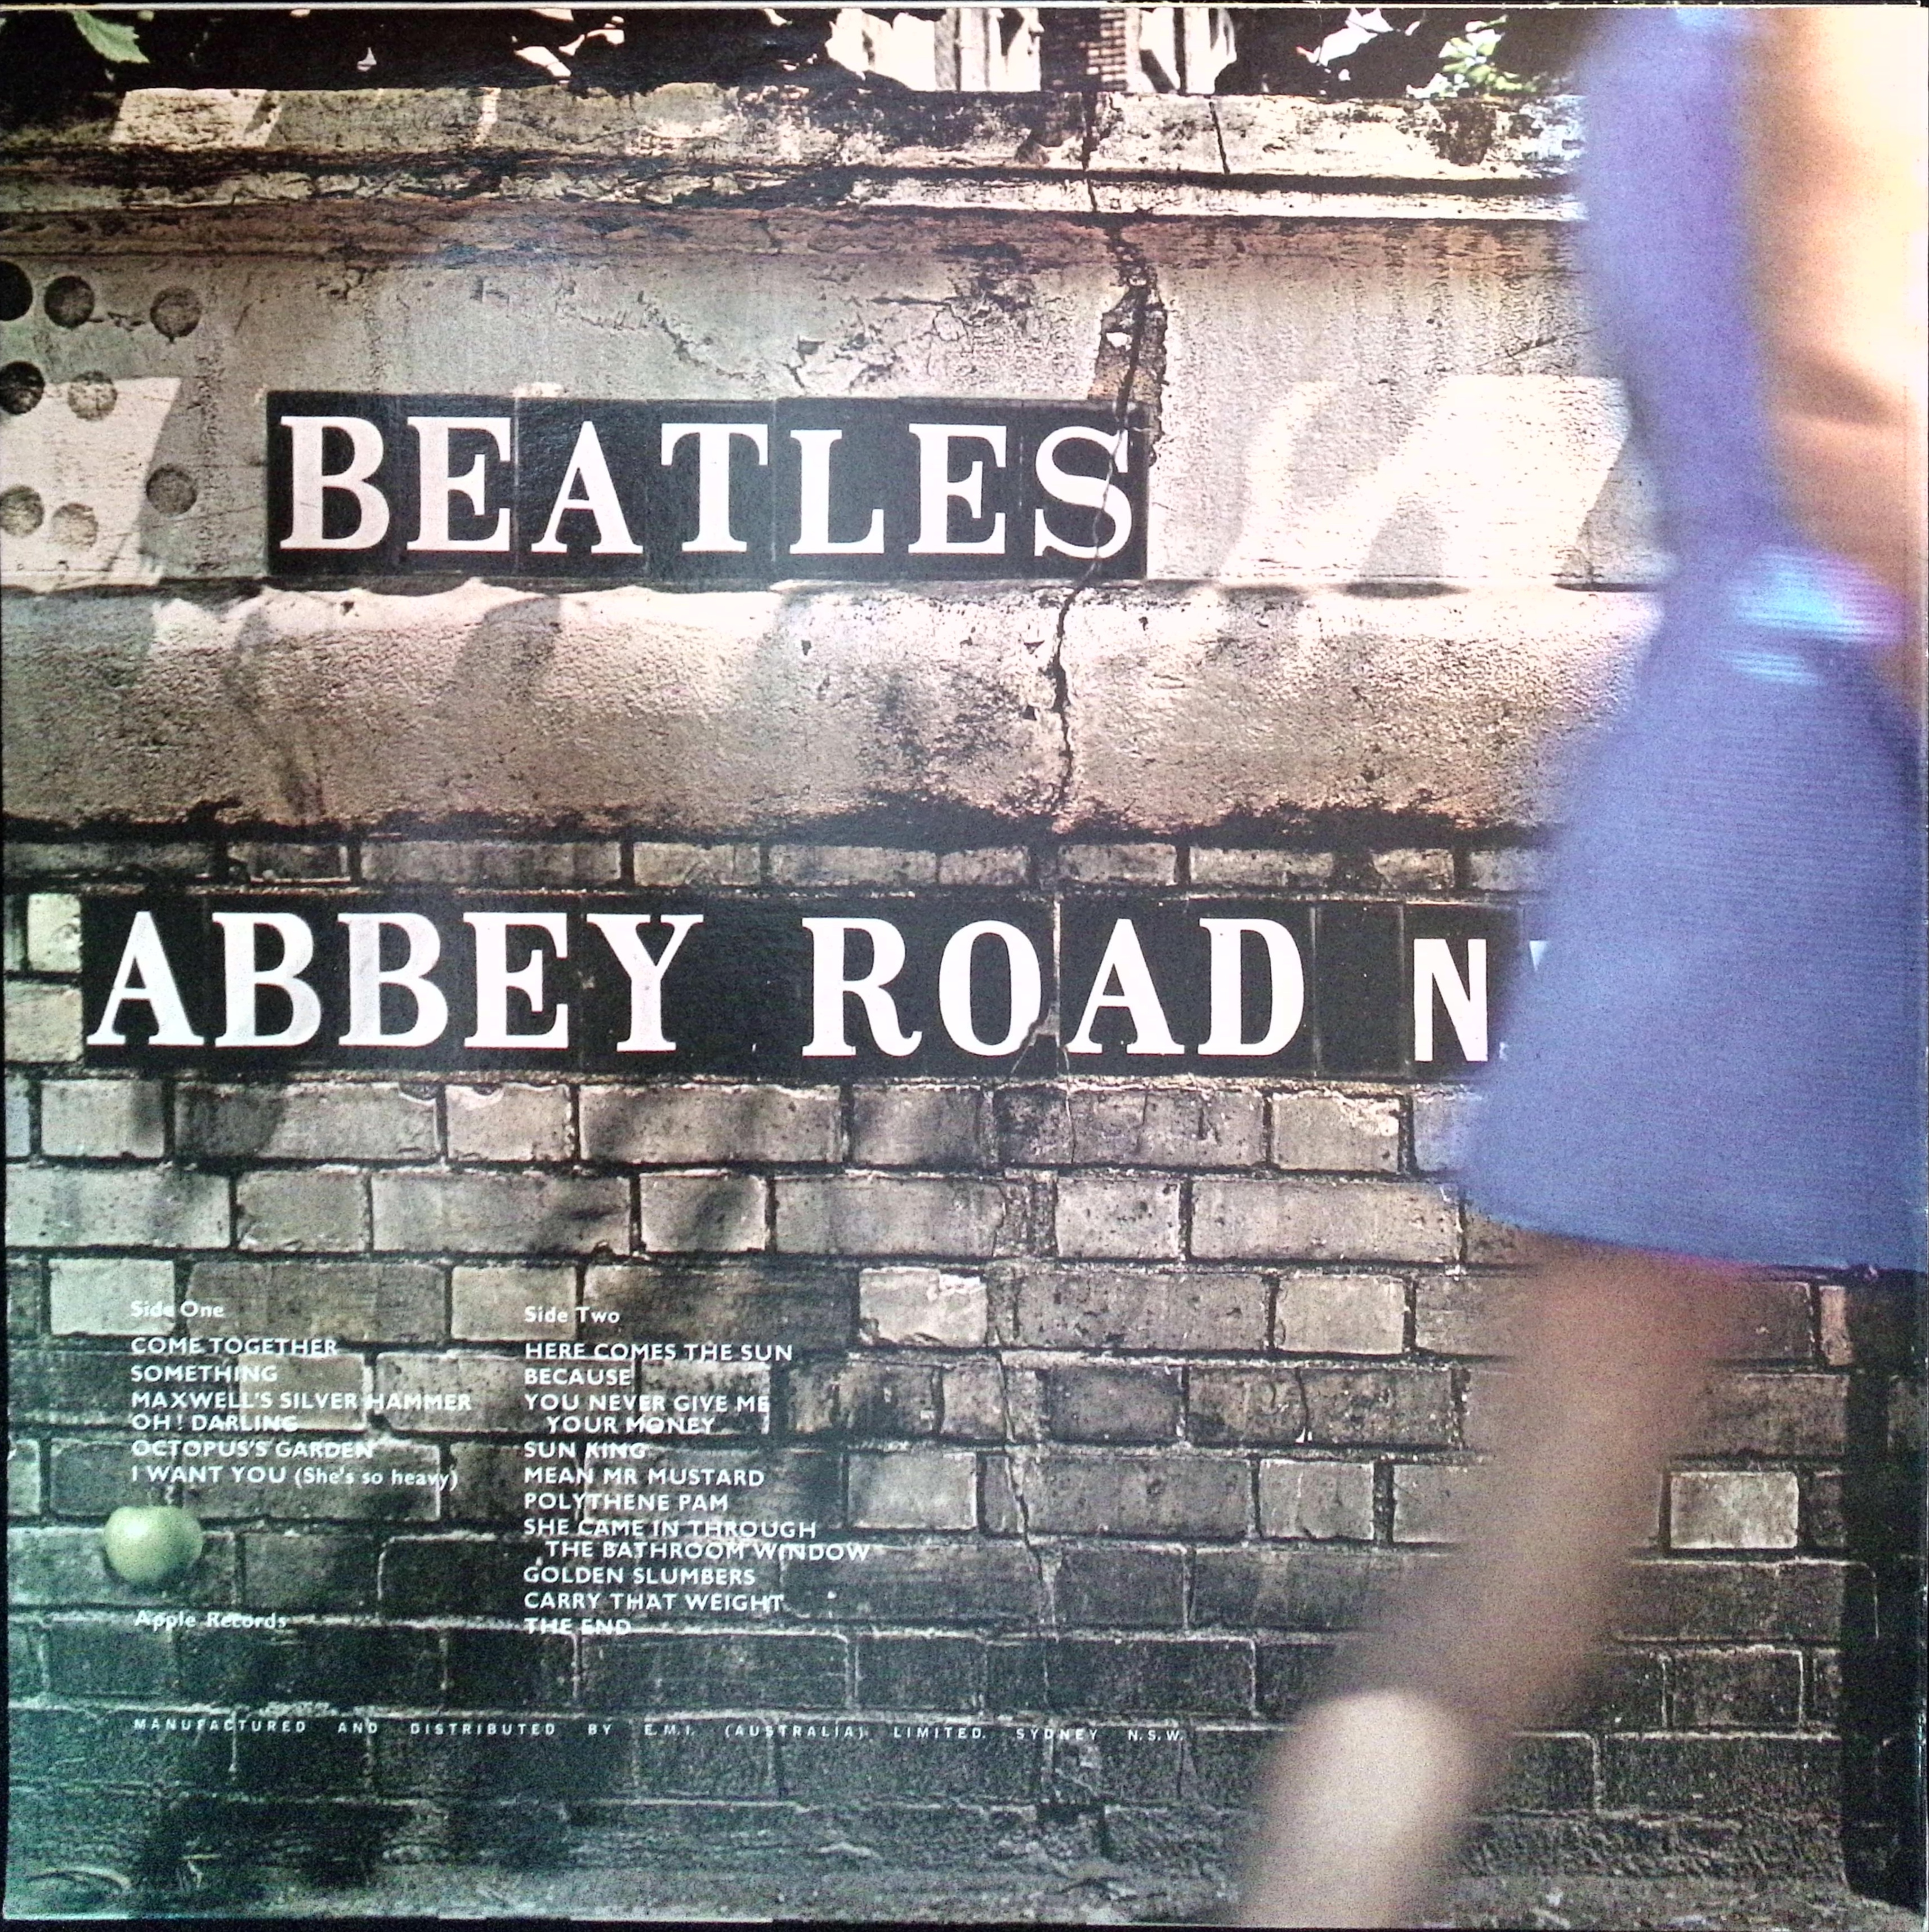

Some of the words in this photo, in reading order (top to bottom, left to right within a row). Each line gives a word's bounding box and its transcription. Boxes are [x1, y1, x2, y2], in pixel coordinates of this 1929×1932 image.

[280, 416, 1132, 559] BEATLES
[86, 910, 704, 1052] ABBEY
[802, 917, 1305, 1057] ROAD
[131, 1300, 175, 1317] Side
[180, 1301, 224, 1318] One
[524, 1306, 568, 1323] Side
[575, 1306, 620, 1323] Two
[131, 1337, 203, 1354] COME
[208, 1337, 338, 1356] TOGETHER
[525, 1342, 585, 1359] HERE
[594, 1343, 676, 1360] COMES
[684, 1344, 732, 1361] THE
[741, 1344, 792, 1362] SUN
[131, 1365, 278, 1382] SOMETHING
[525, 1368, 631, 1386] BECAUSE
[132, 1391, 274, 1408] MAXWELL'S
[280, 1392, 358, 1409] SILVER
[367, 1393, 471, 1411] HAMMER
[525, 1394, 579, 1411] YOU
[590, 1394, 666, 1412] NEVER
[674, 1395, 728, 1412] GIVE
[737, 1395, 770, 1413] ME
[191, 1414, 298, 1433] DARLING
[546, 1416, 619, 1434] YOUR
[626, 1416, 715, 1434] MONEY
[132, 1440, 268, 1457] OCTOPUS'S
[275, 1441, 373, 1459] GARDEN
[524, 1441, 575, 1458] SUN
[585, 1442, 646, 1459] KING
[132, 1465, 138, 1482] I
[146, 1466, 224, 1483] WANT
[231, 1466, 287, 1483] YOU
[294, 1467, 355, 1489] (She's
[362, 1472, 383, 1485] so
[391, 1469, 458, 1492] heavy)
[524, 1467, 595, 1484] MEAN
[604, 1467, 637, 1484] MR
[648, 1468, 765, 1487] MUSTARD
[524, 1493, 670, 1511] POLYTHENE
[679, 1493, 729, 1511] PAM
[524, 1519, 569, 1536] SHE
[578, 1519, 644, 1537] CAME
[653, 1520, 679, 1537] IN
[688, 1520, 816, 1538] THROUGH
[545, 1541, 593, 1558] THE
[603, 1541, 744, 1560] BATHROOM
[754, 1542, 871, 1561] WINDOW
[524, 1567, 624, 1584] GOLDEN
[633, 1567, 756, 1586] SLUMBERS
[524, 1592, 601, 1609] CARRY
[609, 1593, 677, 1610] THAT
[685, 1592, 785, 1613] WEIGHT
[135, 1610, 196, 1632] Apple
[207, 1611, 287, 1629] Records
[524, 1618, 573, 1635] THE
[582, 1618, 632, 1635] END
[134, 1718, 306, 1733] MANUFACTURED
[338, 1722, 378, 1734] AND
[410, 1723, 556, 1735] DISTRIBUTED
[588, 1724, 612, 1735] BY
[1016, 1728, 1098, 1741] SYDNEY
